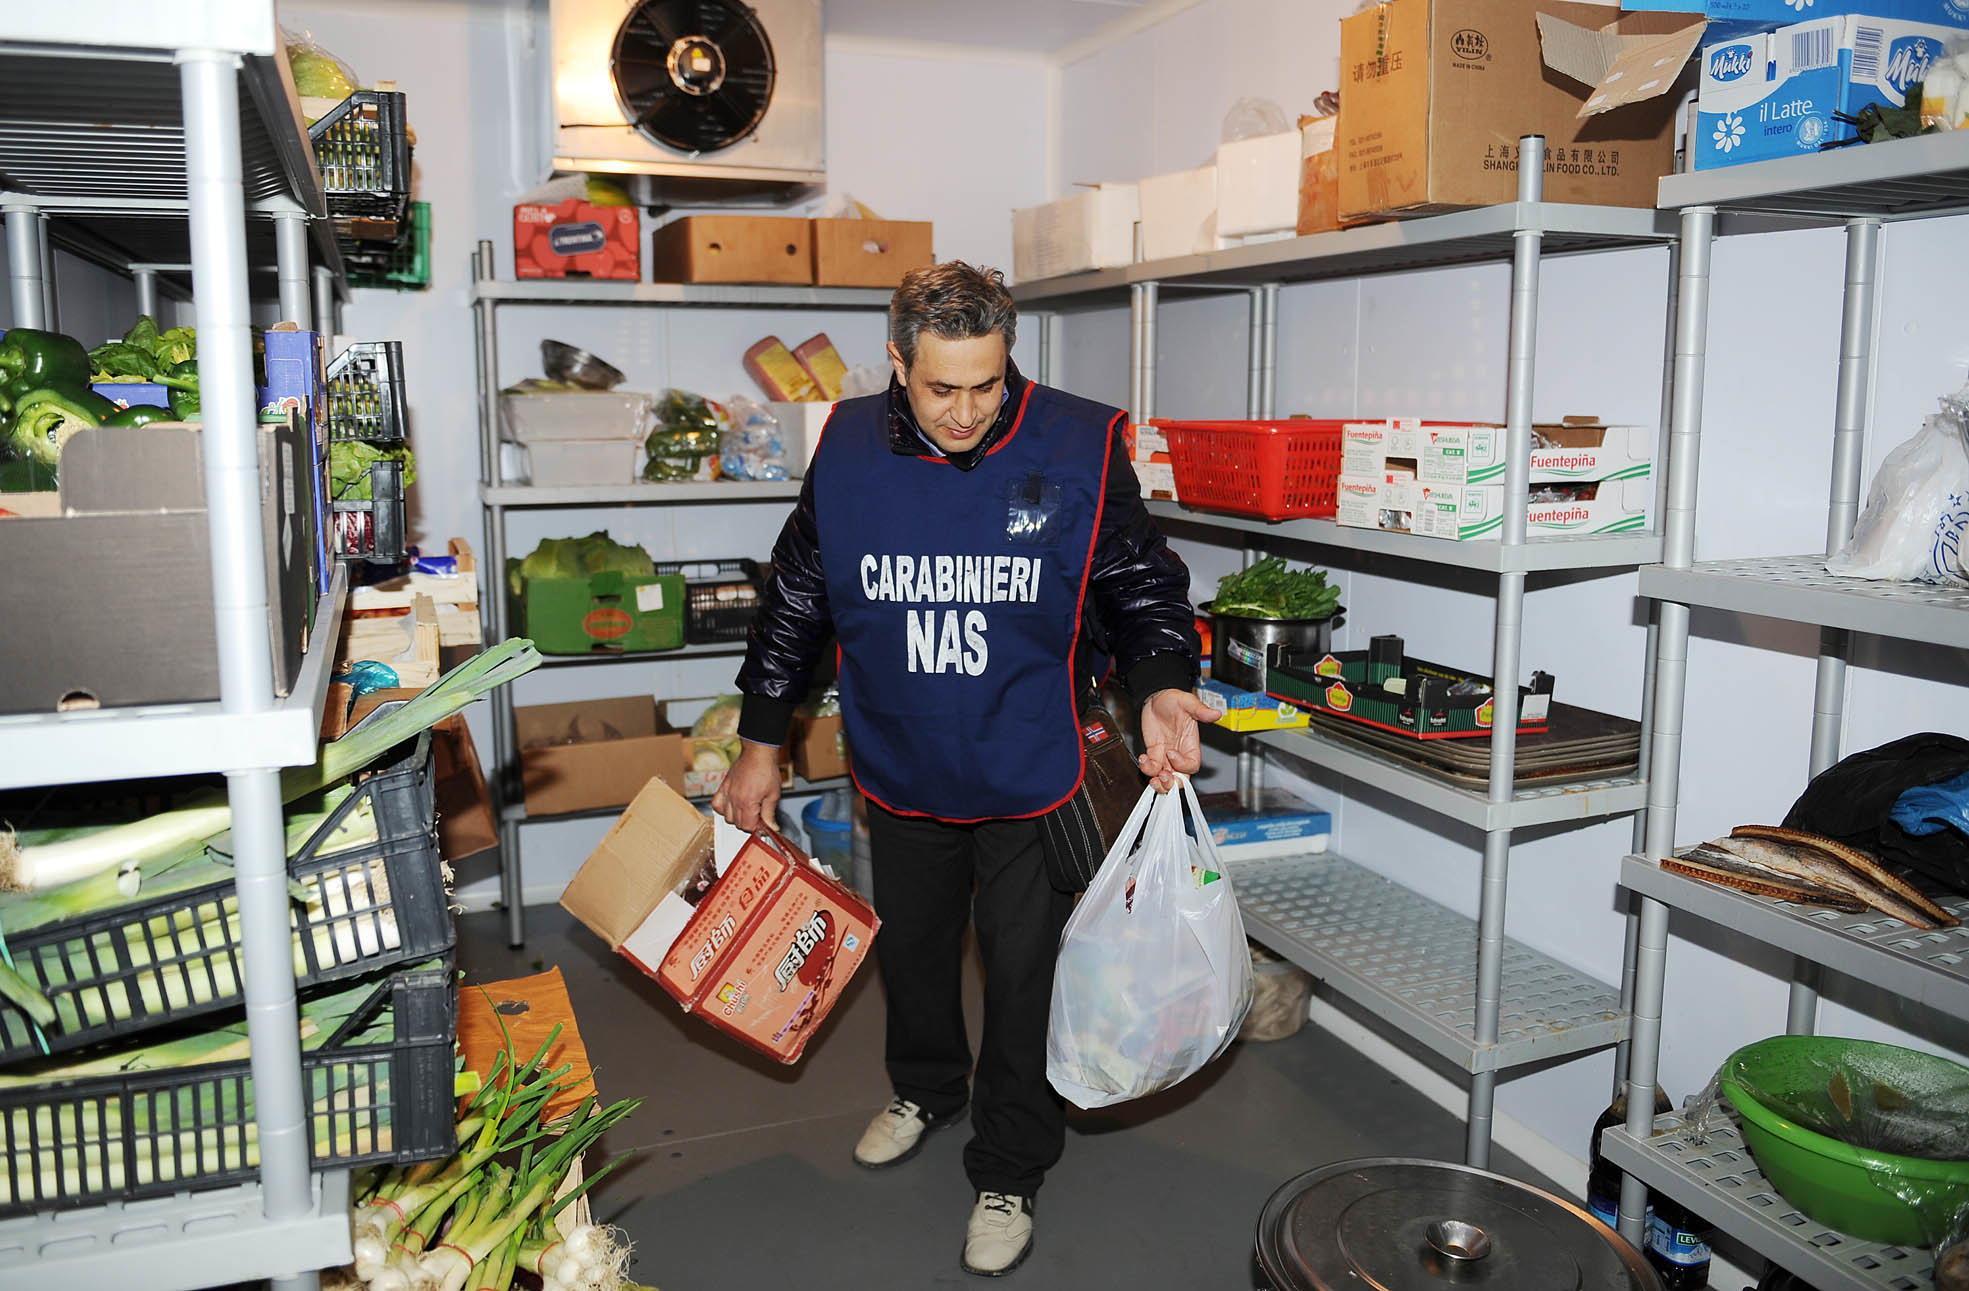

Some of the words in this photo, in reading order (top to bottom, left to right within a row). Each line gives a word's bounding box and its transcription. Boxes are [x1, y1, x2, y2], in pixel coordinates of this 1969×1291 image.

[1353, 50, 1404, 83] 请勿重压
[1709, 51, 1753, 78] Mukki
[1760, 104, 1768, 123] il
[1772, 99, 1813, 120] Latte
[1763, 123, 1793, 137] intero
[1484, 144, 1620, 165] 上海义食品有限公司
[1556, 163, 1580, 175] FOOD
[1601, 166, 1619, 177] LTD.
[1346, 429, 1383, 440] Fuentepiña
[1530, 453, 1596, 471] Fuentepiña
[1341, 482, 1377, 494] Fuentepiña
[1528, 507, 1589, 524] uentepiña
[860, 554, 1042, 604] CARABINIERI
[906, 609, 989, 676] NAS
[722, 980, 747, 1017] Chushi
